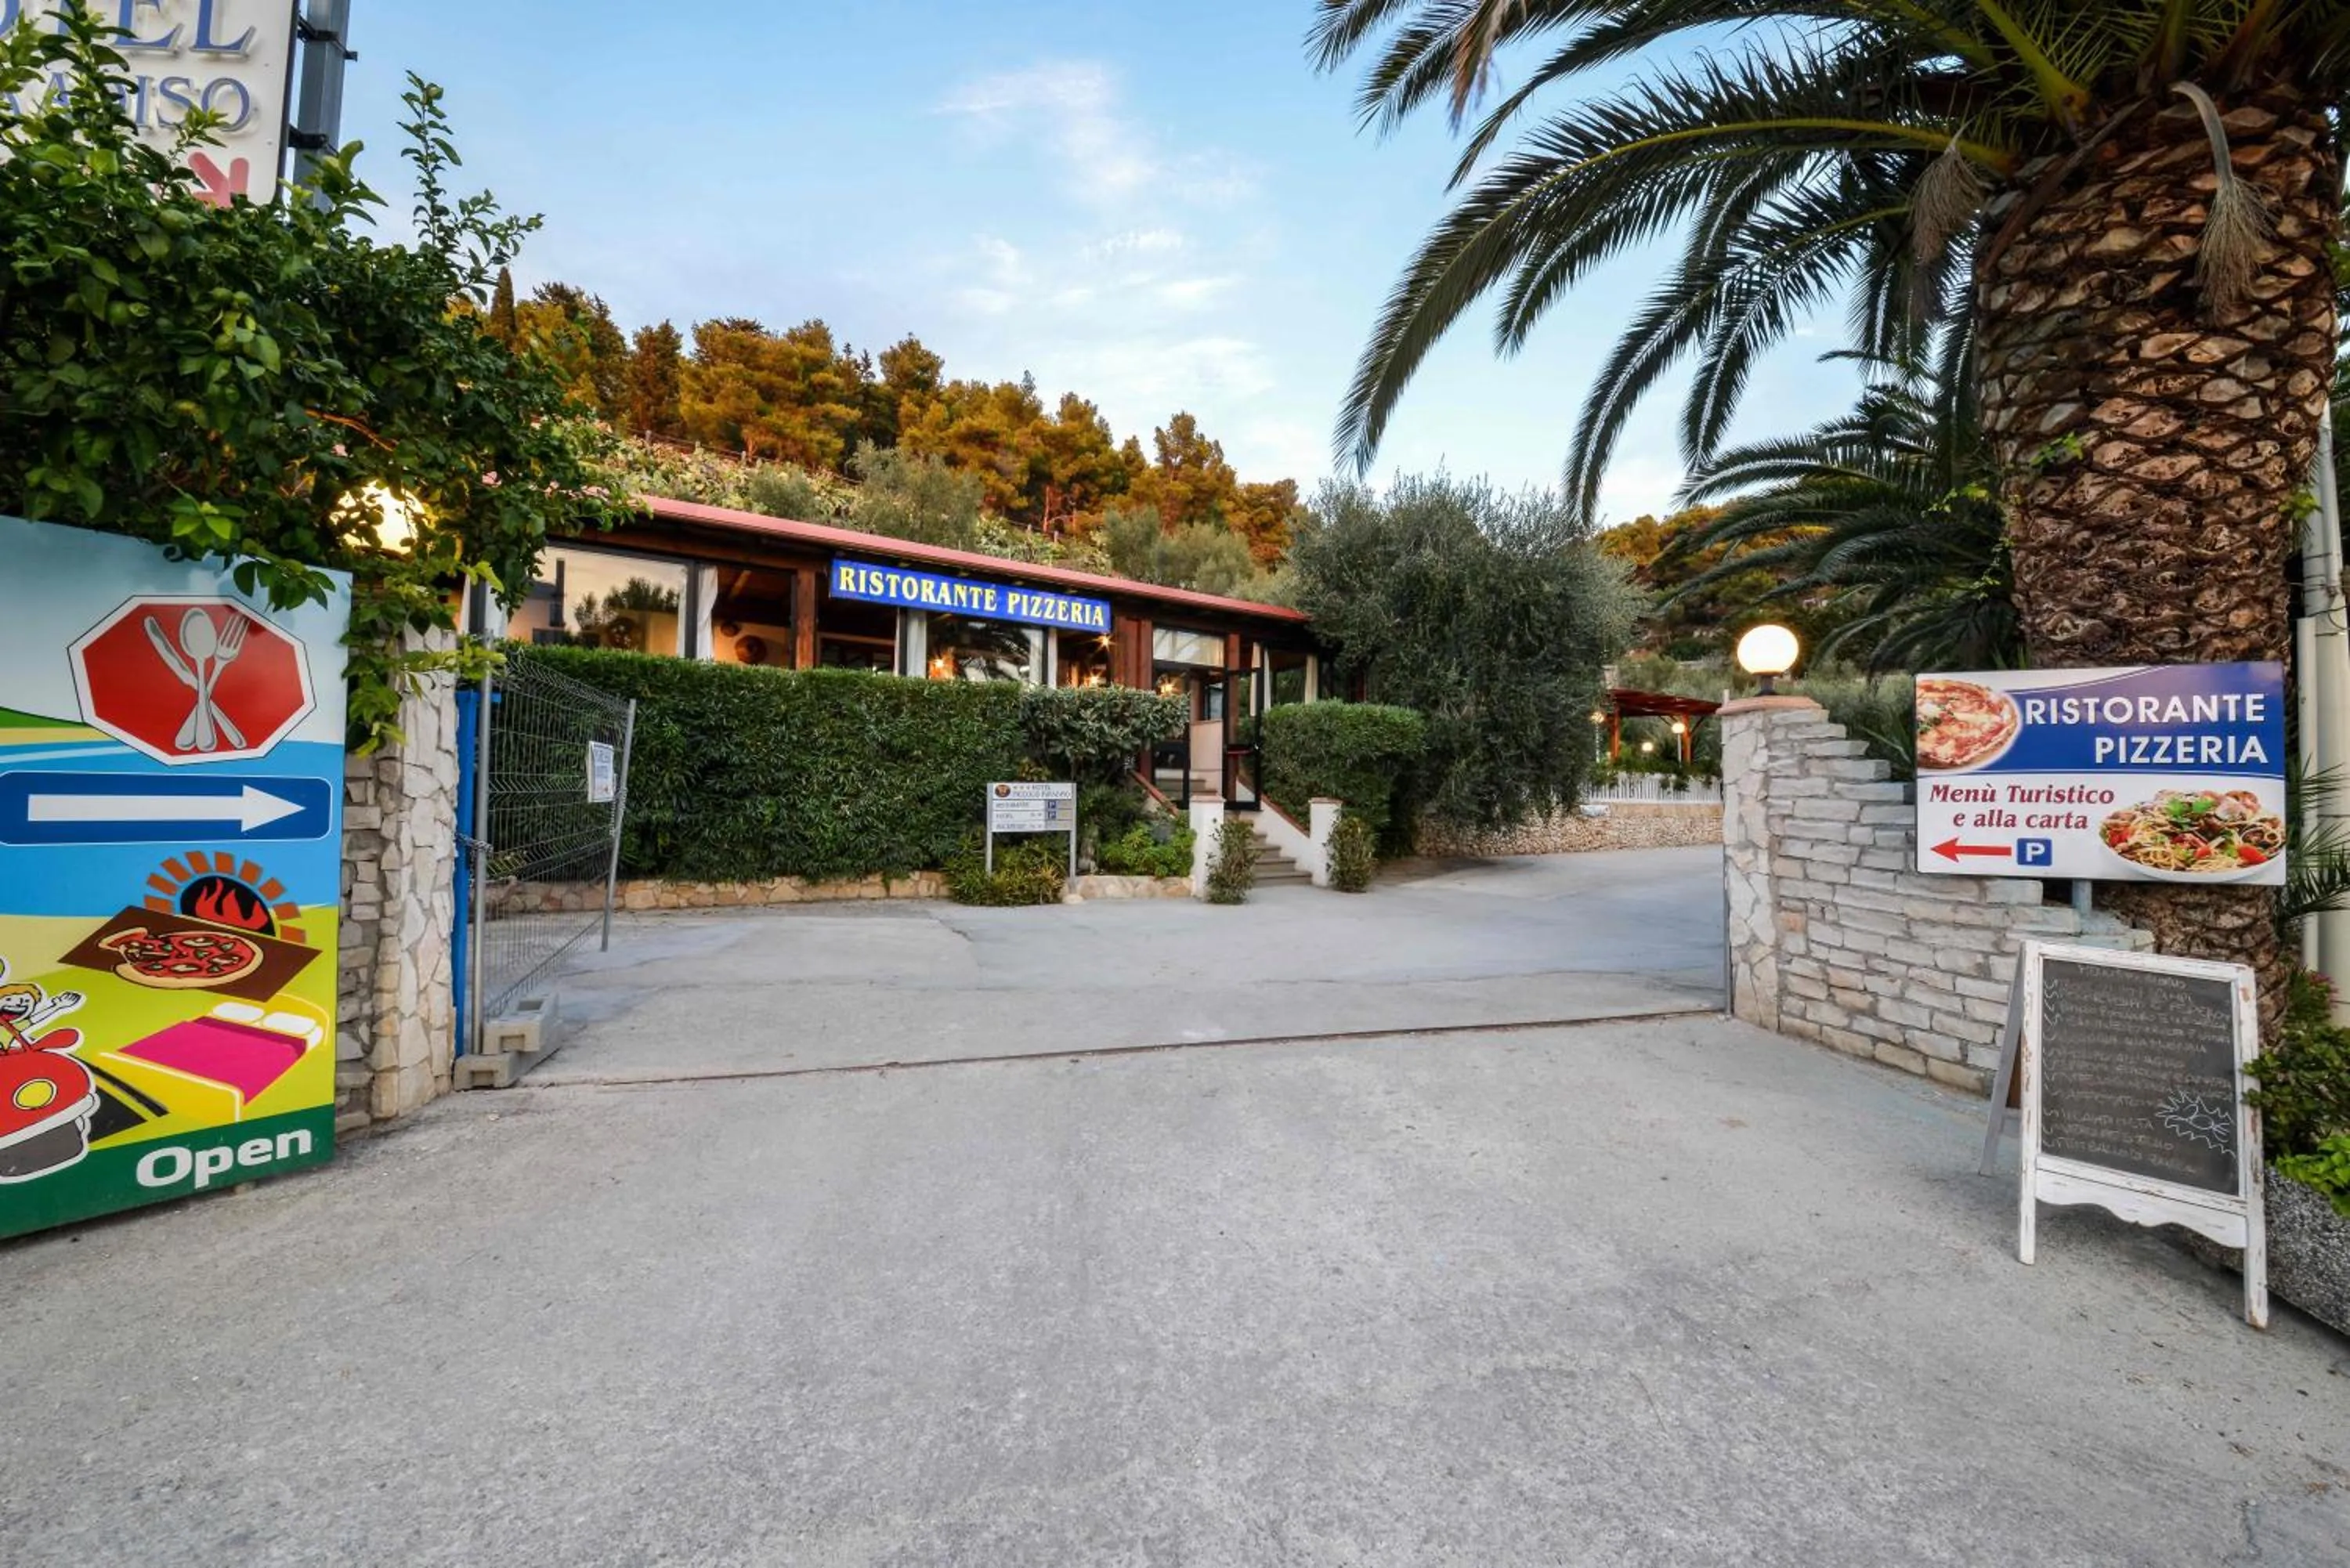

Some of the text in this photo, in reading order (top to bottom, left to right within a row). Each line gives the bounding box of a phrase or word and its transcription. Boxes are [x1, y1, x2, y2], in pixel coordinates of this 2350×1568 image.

[838, 565, 1104, 627] RISTORANTE PIZZERIA
[2024, 692, 2266, 725] RISTORANTE
[2094, 735, 2269, 764] PIZZERIA
[1929, 783, 2115, 805] Menù Turistico
[1952, 809, 2088, 830] e alla carta
[2026, 842, 2046, 862] P
[136, 1127, 313, 1190] Open
